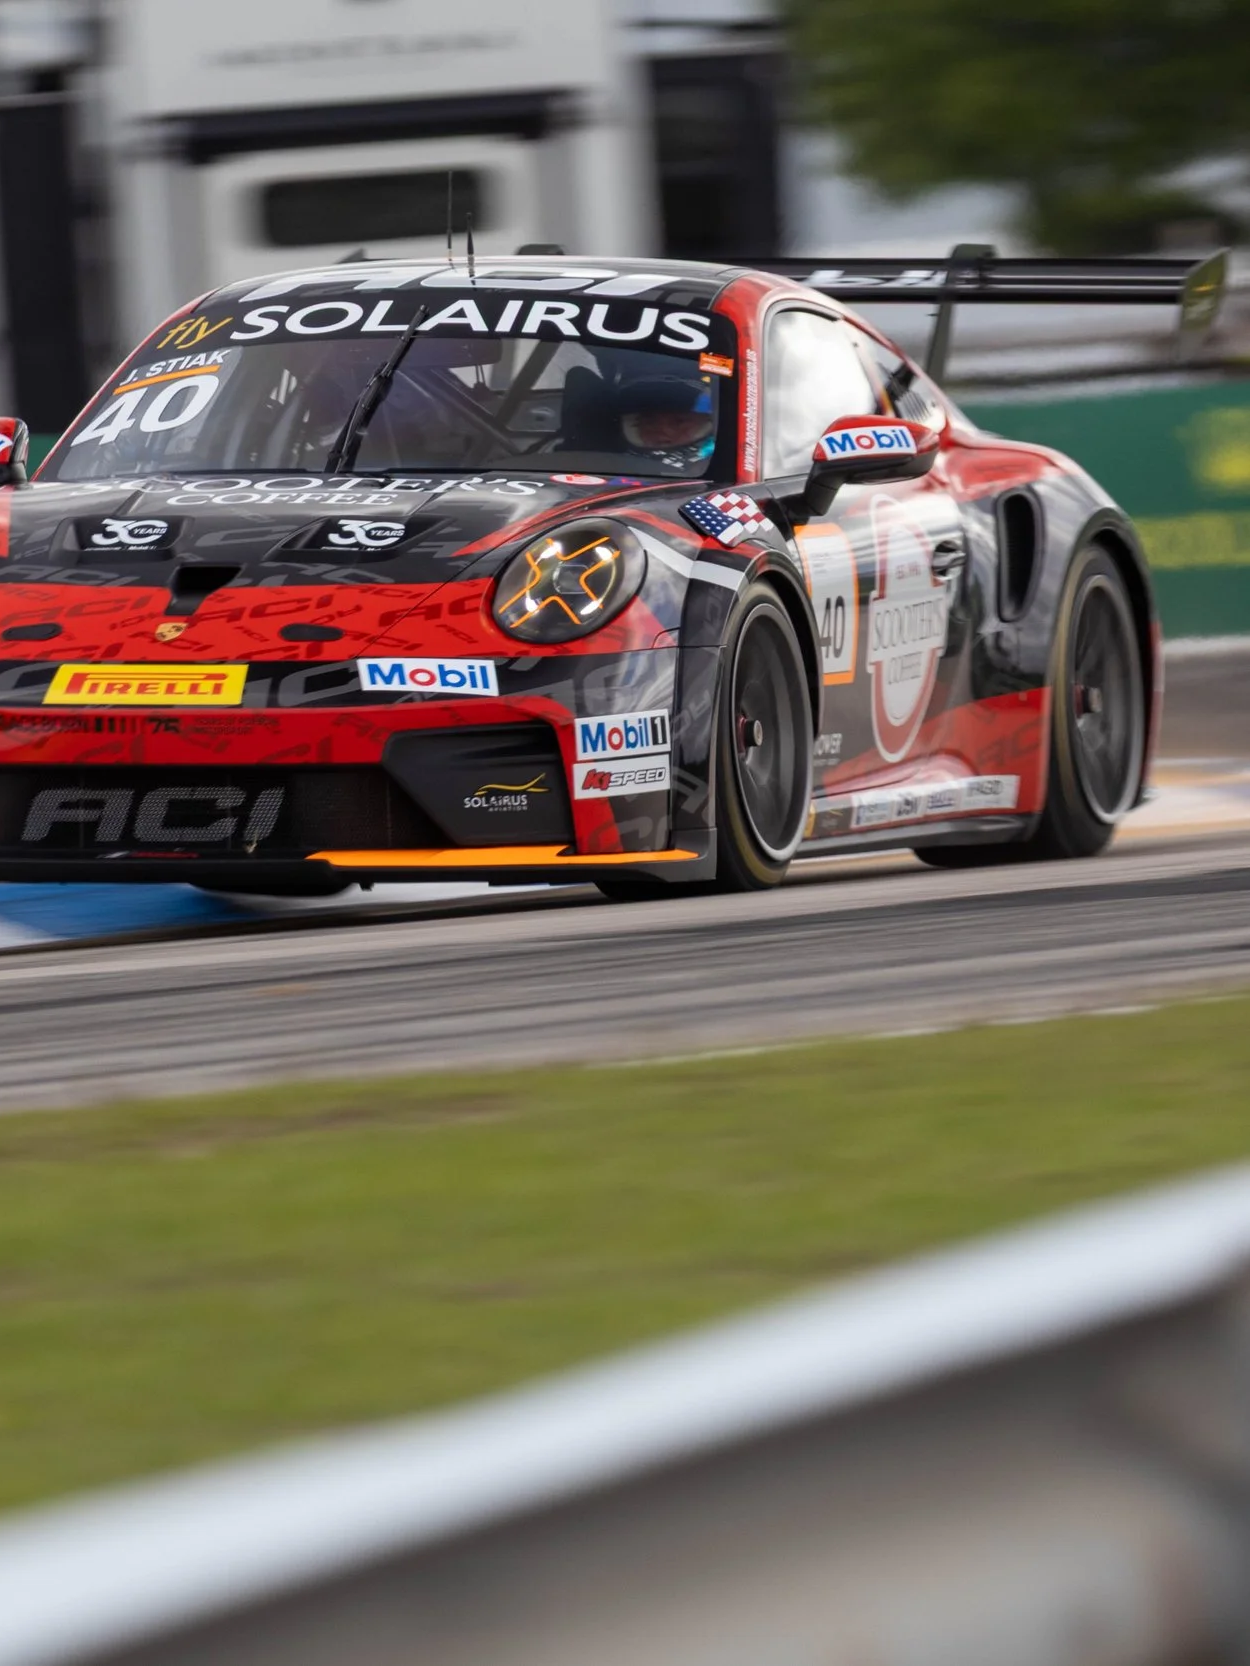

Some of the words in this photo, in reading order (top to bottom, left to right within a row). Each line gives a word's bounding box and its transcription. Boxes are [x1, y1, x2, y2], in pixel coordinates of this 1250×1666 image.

[157, 316, 233, 349] fly
[230, 299, 711, 350] SOLAIRUS
[120, 369, 138, 386] J.
[146, 349, 232, 377] STIAK
[70, 374, 220, 448] 40
[825, 428, 911, 454] Mobil
[166, 492, 398, 506] COFFEE
[91, 518, 168, 545] 30
[133, 527, 168, 535] YEARS
[328, 519, 405, 546] 30
[370, 529, 405, 537] YEARS
[820, 595, 845, 659] 40
[64, 672, 228, 696] PIRELLI
[367, 663, 490, 690] Mobil
[581, 719, 649, 753] Mobil
[651, 715, 668, 746] 1
[21, 786, 286, 842] ACI
[463, 795, 528, 809] SOLAIRUS
